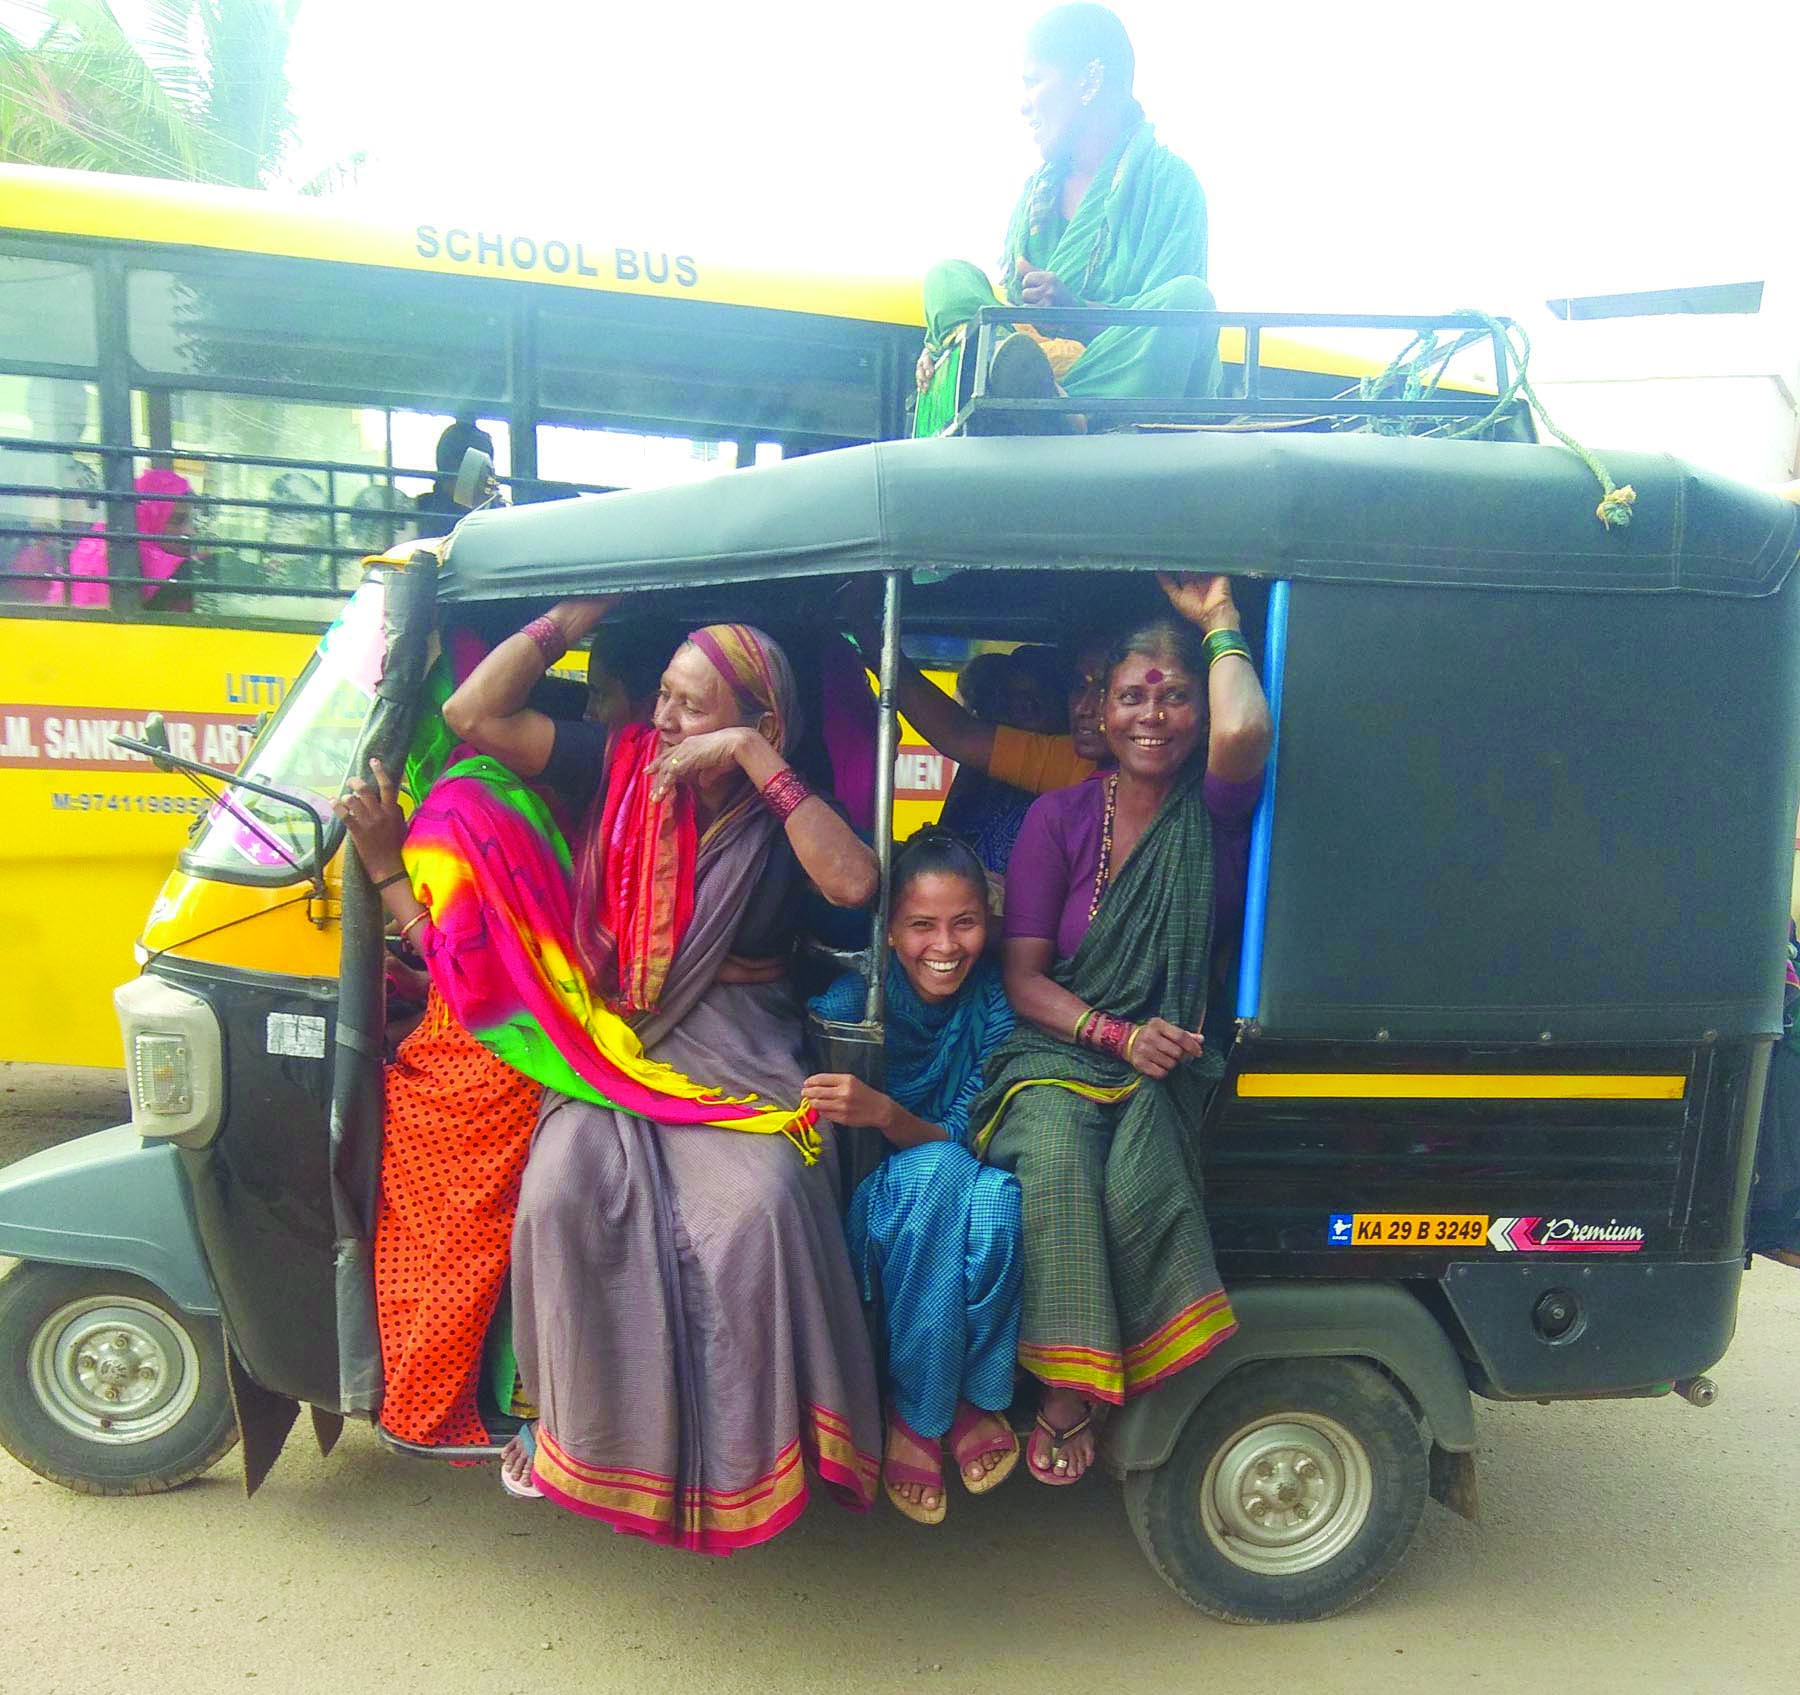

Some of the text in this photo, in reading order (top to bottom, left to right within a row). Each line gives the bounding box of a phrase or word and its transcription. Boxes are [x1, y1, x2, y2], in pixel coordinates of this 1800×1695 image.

[415, 224, 699, 288] SCHOOL BUS
[1357, 1221, 1482, 1240] KA 29 B 3249
[1540, 1218, 1645, 1245] Premium
